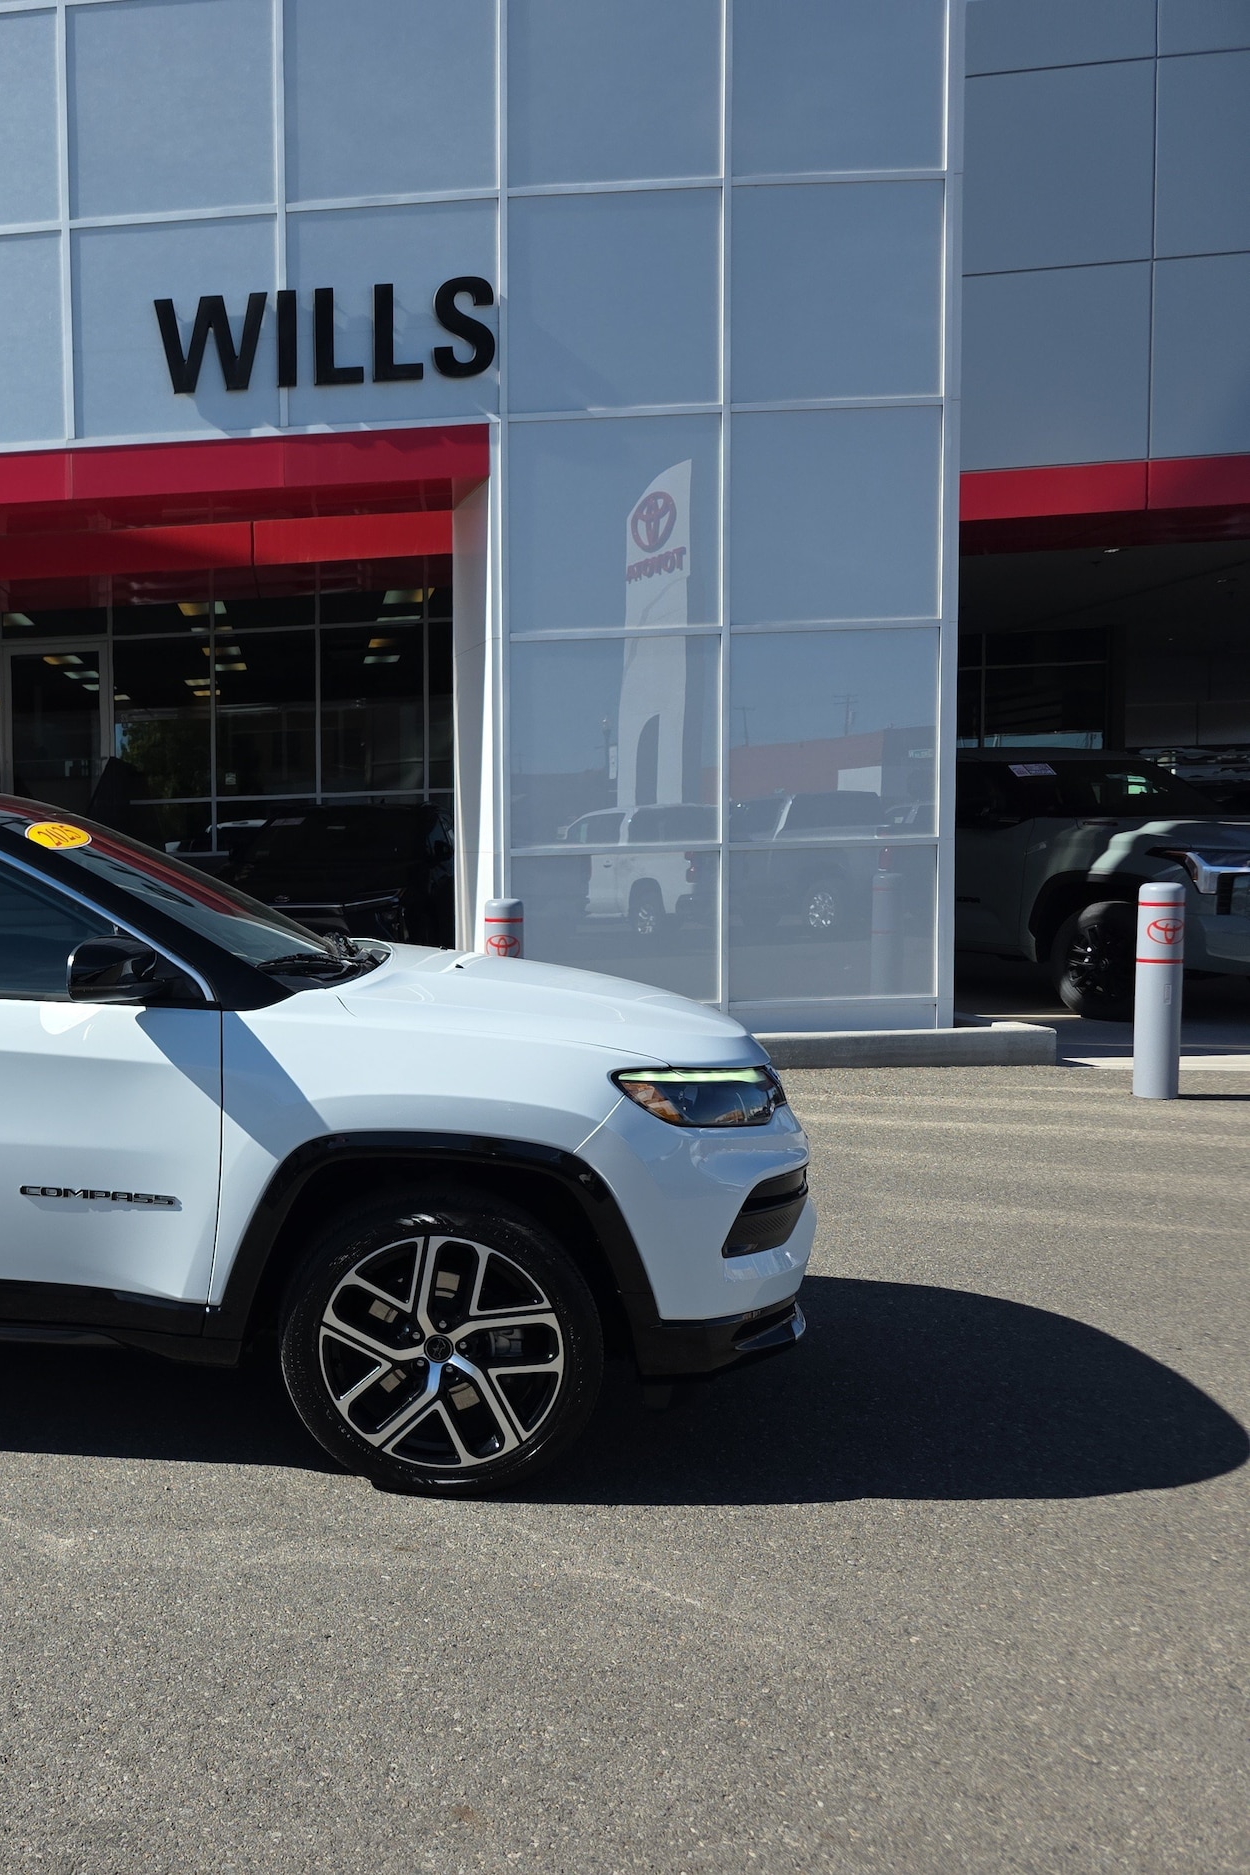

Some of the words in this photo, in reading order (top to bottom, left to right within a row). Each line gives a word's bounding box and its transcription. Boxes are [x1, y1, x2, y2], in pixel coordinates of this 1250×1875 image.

[153, 276, 496, 394] WILLS
[37, 825, 82, 847] 2025
[19, 1185, 179, 1206] COMPASS
